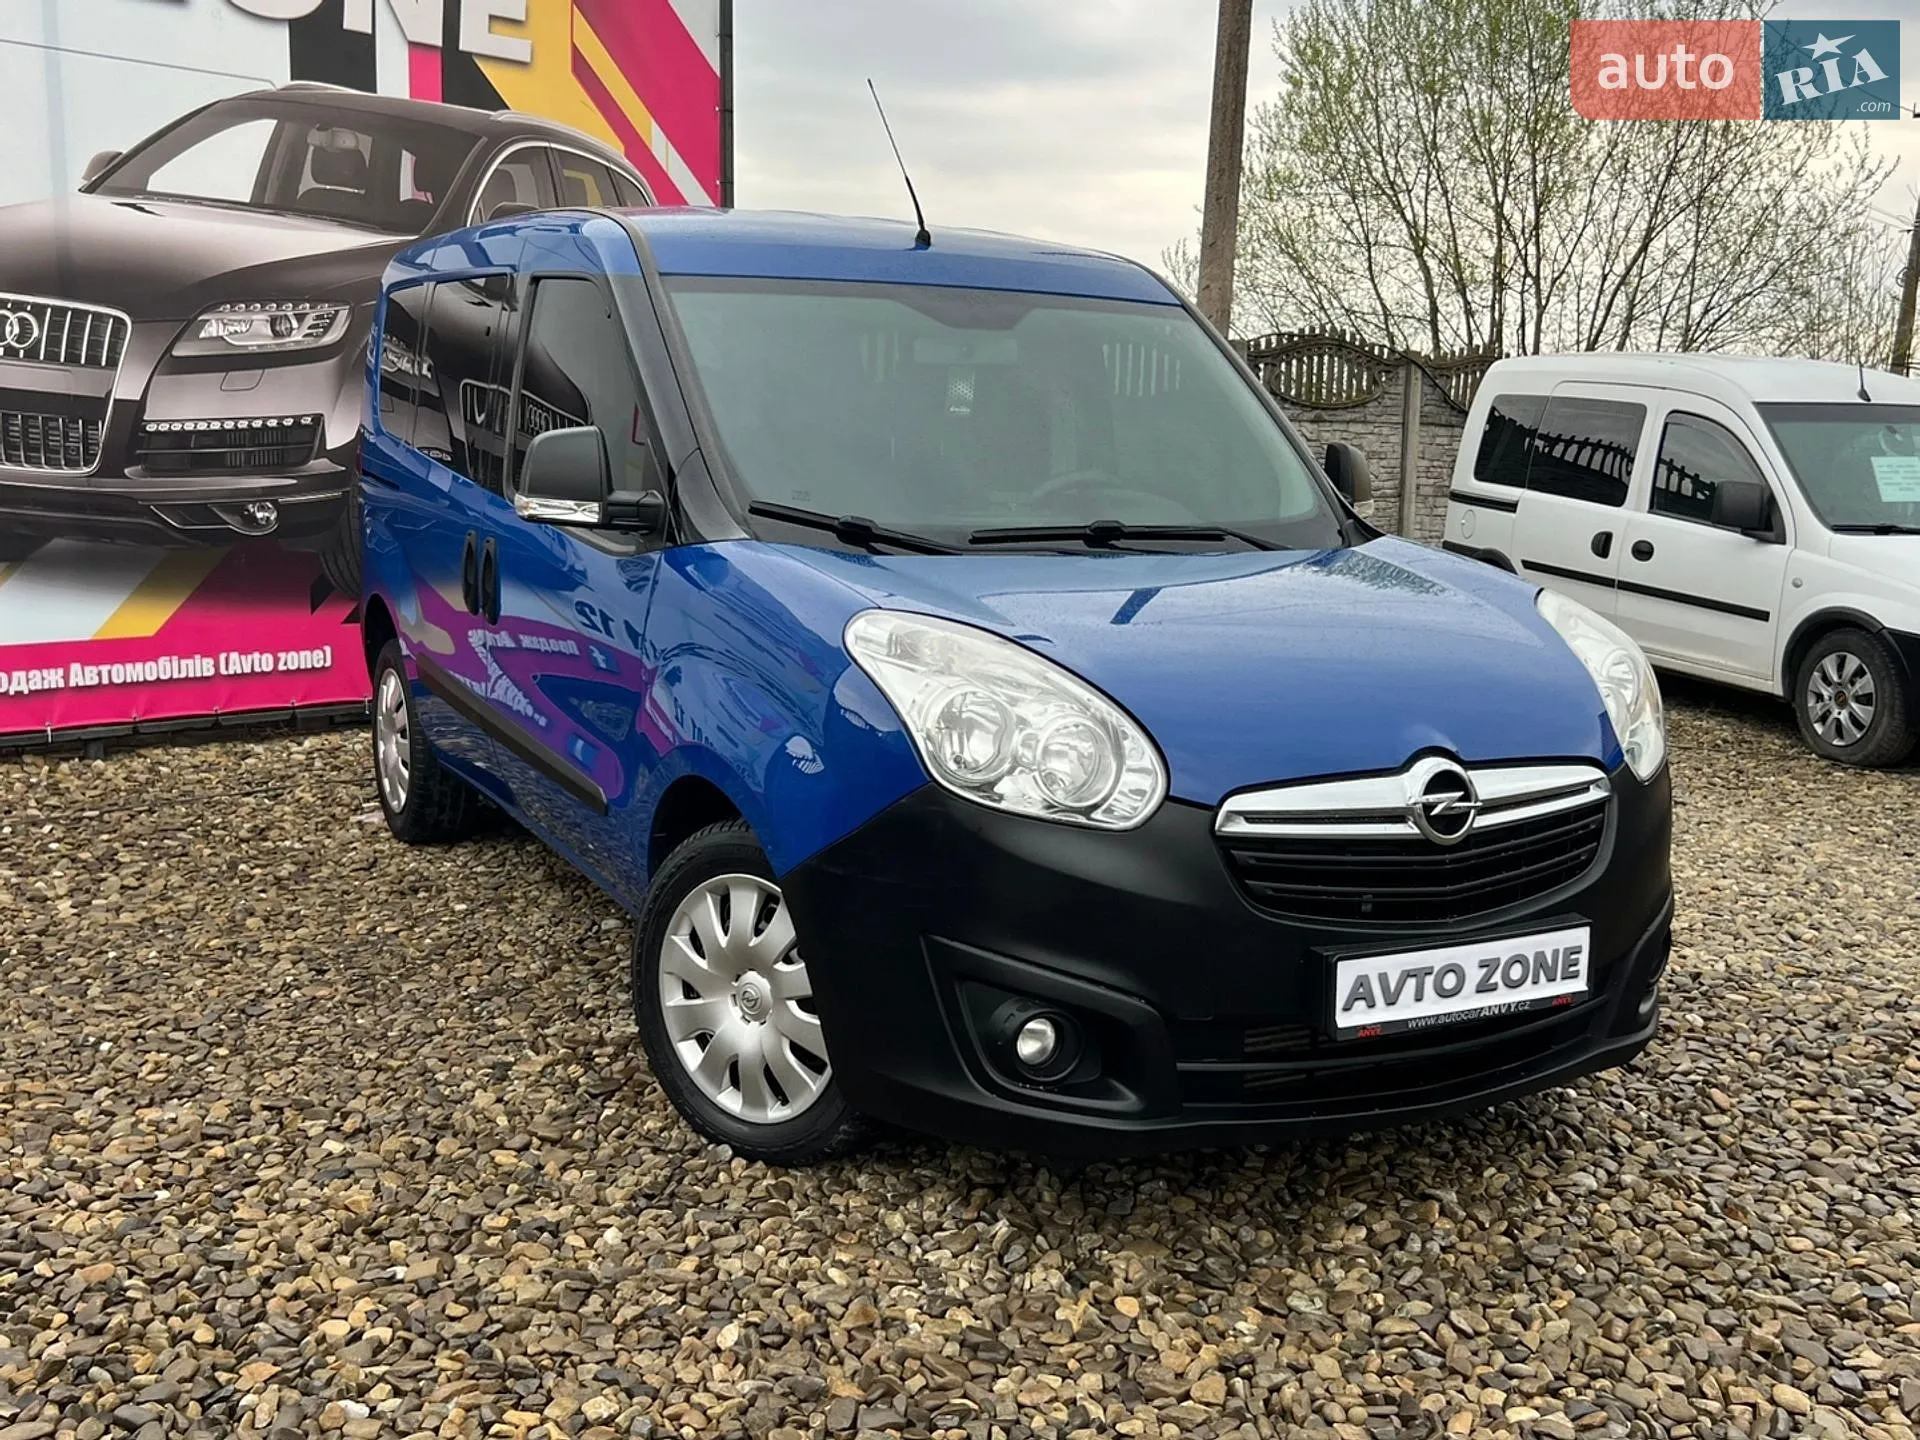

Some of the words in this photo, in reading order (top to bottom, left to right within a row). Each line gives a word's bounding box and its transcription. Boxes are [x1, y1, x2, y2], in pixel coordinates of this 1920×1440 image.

[69, 654, 215, 687] Автомобілів
[219, 651, 274, 675] (Avto
[277, 645, 332, 671] zone)
[1342, 963, 1466, 1011] AVTO
[1475, 945, 1583, 994] ZONE
[1407, 1001, 1531, 1029] www.autocarANVY.cz
